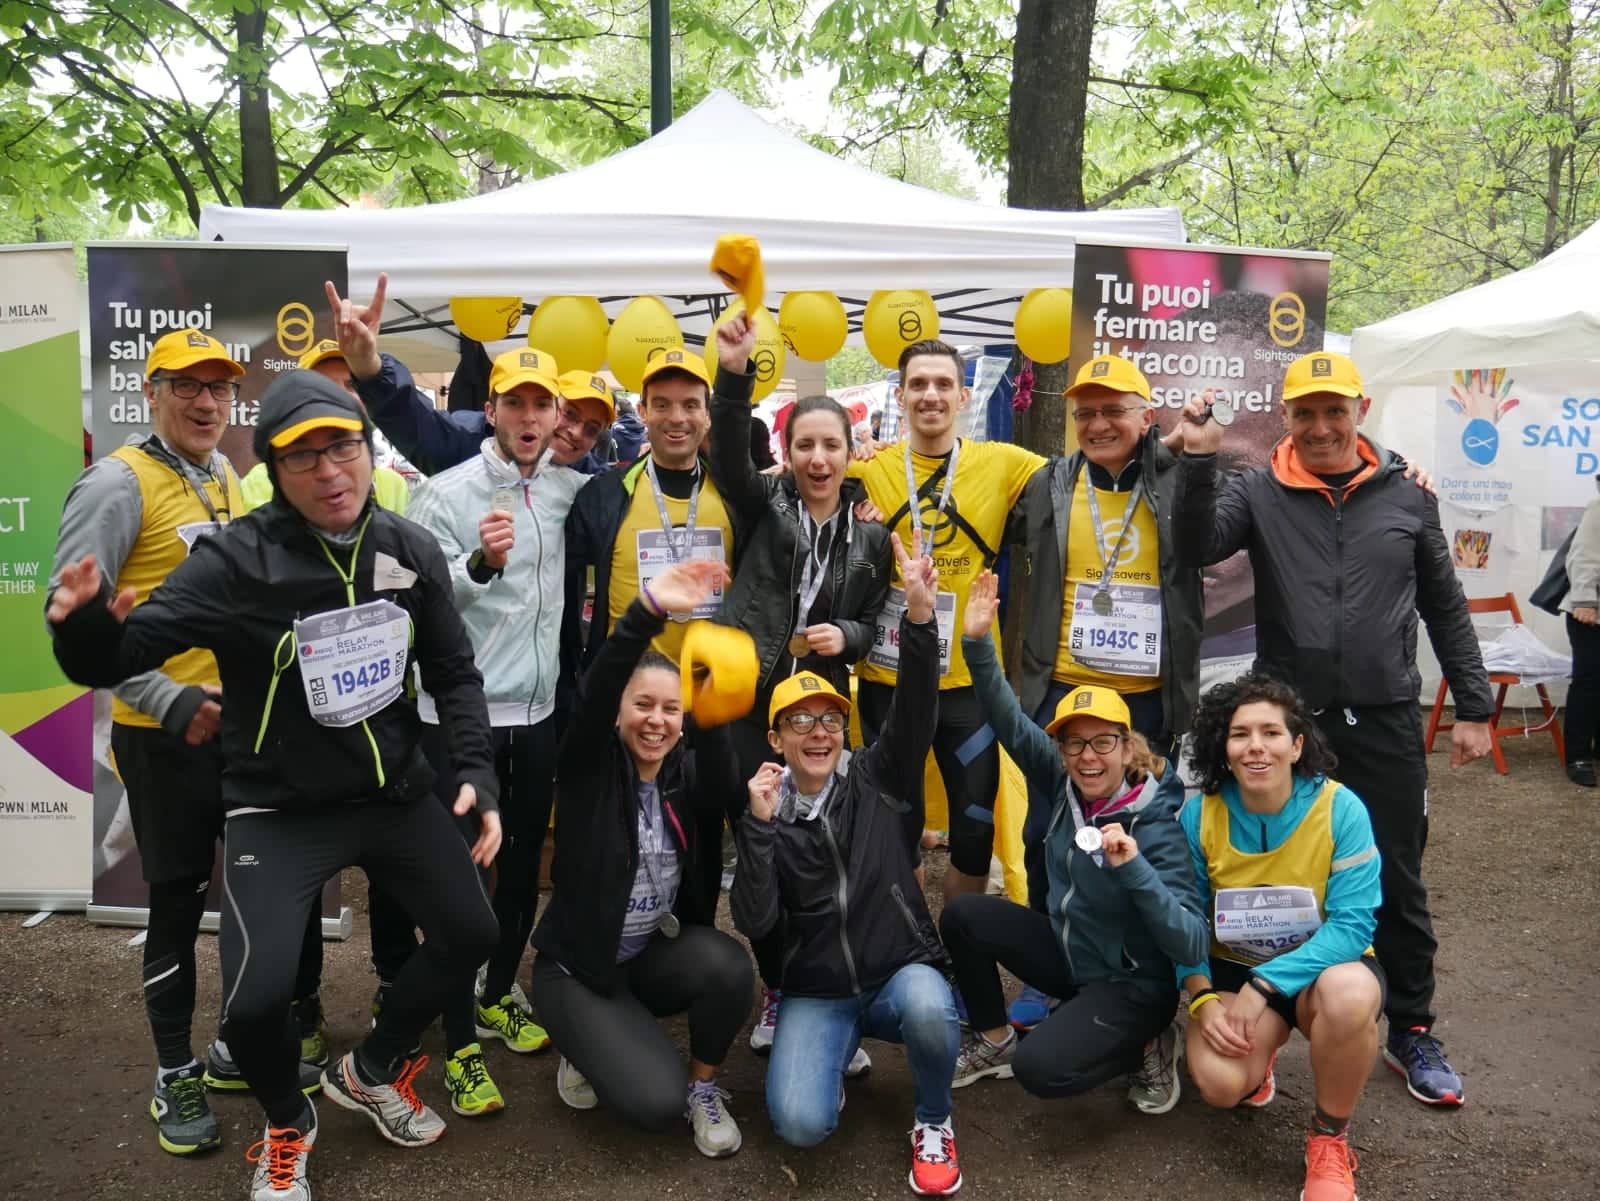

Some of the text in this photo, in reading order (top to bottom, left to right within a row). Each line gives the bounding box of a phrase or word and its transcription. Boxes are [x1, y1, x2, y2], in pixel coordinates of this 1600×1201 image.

[1095, 273, 1211, 312] Tu puoi
[8, 303, 48, 317] MILAN
[108, 301, 213, 333] Tu puoi
[1093, 309, 1217, 343] fermare
[263, 358, 297, 373] Sights
[1121, 345, 1245, 378] tracoma
[1562, 398, 1600, 421] SO
[1522, 424, 1591, 448] SAN
[1575, 452, 1599, 475] D
[14, 561, 39, 577] WAY
[0, 580, 35, 594] ETHER
[336, 635, 369, 649] RELAY
[338, 640, 385, 655] MARATHON
[1089, 627, 1139, 650] 1943C
[331, 658, 391, 696] 1942B
[31, 801, 68, 813] MILAN
[1245, 914, 1274, 923] RELAY
[1246, 921, 1290, 929] MARATHON
